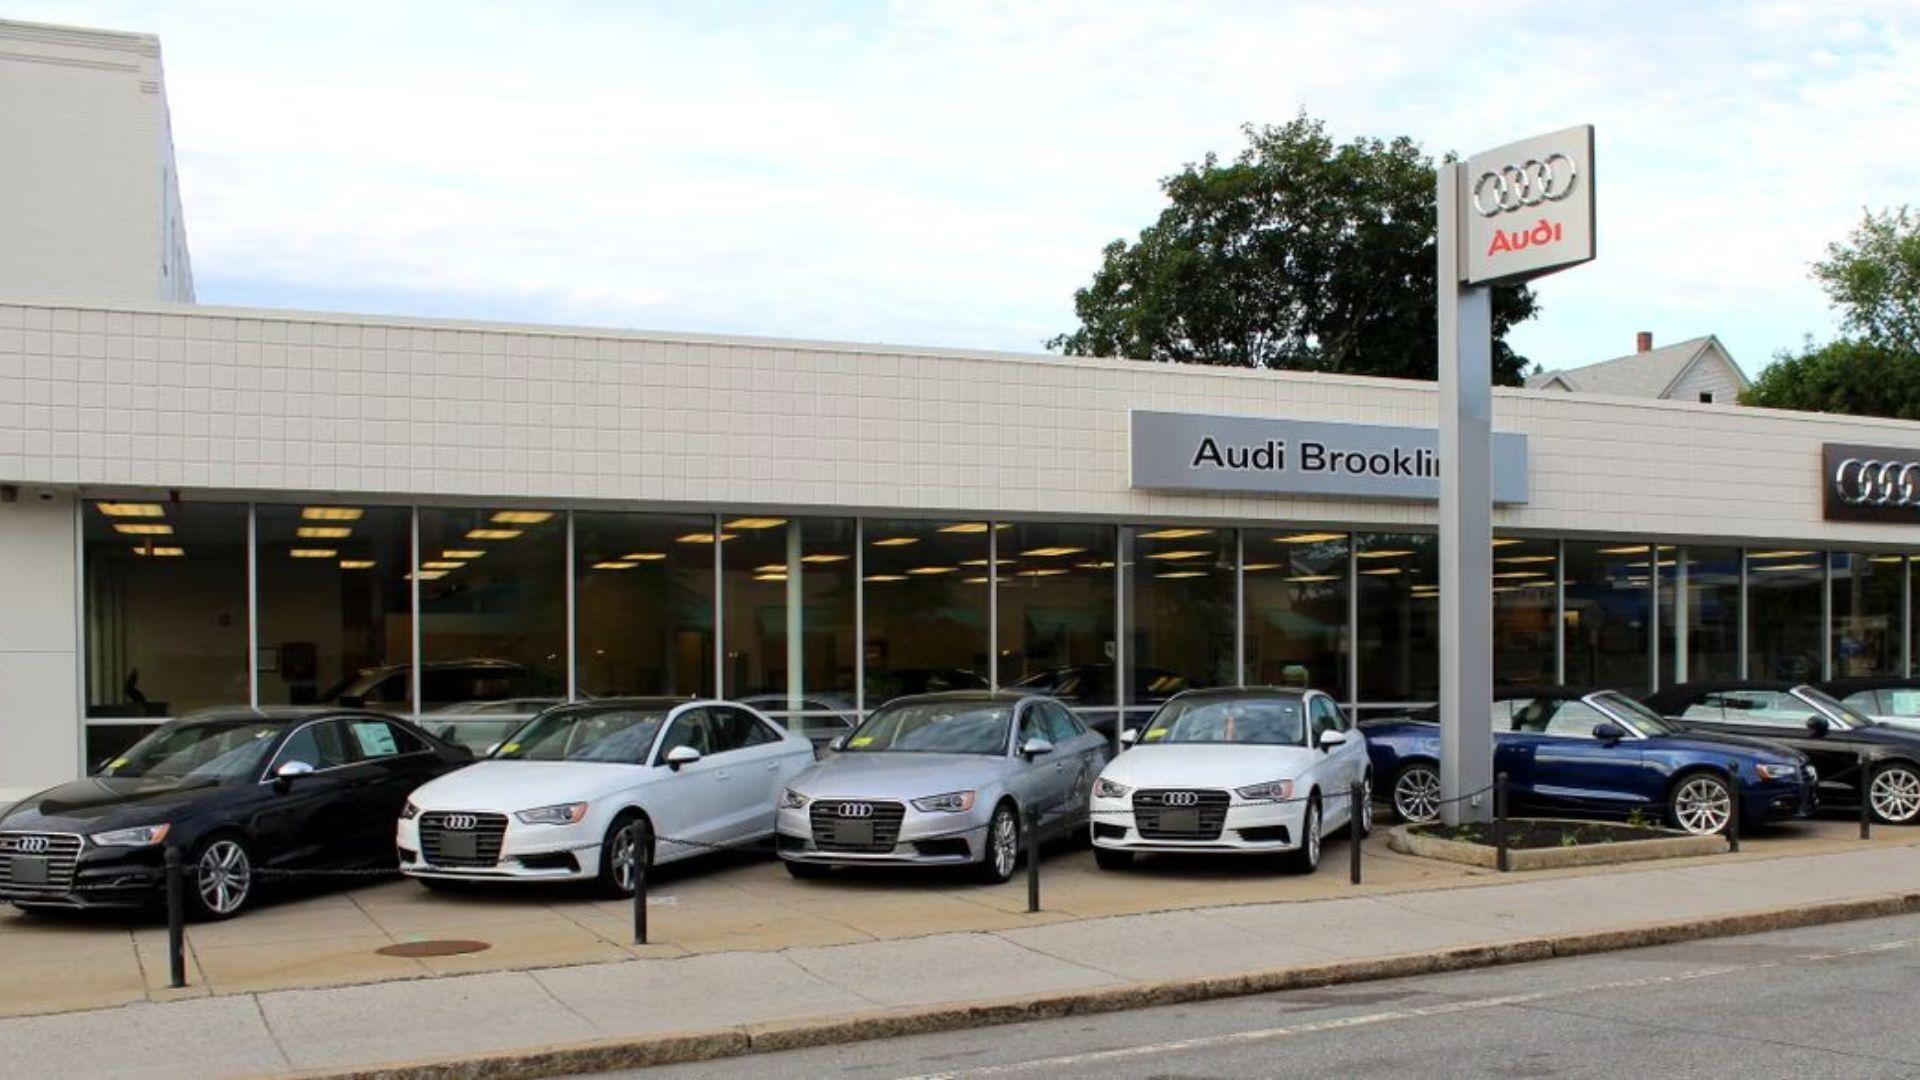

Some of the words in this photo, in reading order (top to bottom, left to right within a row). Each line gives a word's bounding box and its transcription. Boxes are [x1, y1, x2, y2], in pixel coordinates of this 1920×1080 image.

[1487, 218, 1562, 257] Audi
[1193, 436, 1285, 471] Audi
[1301, 442, 1440, 477] Brookli
